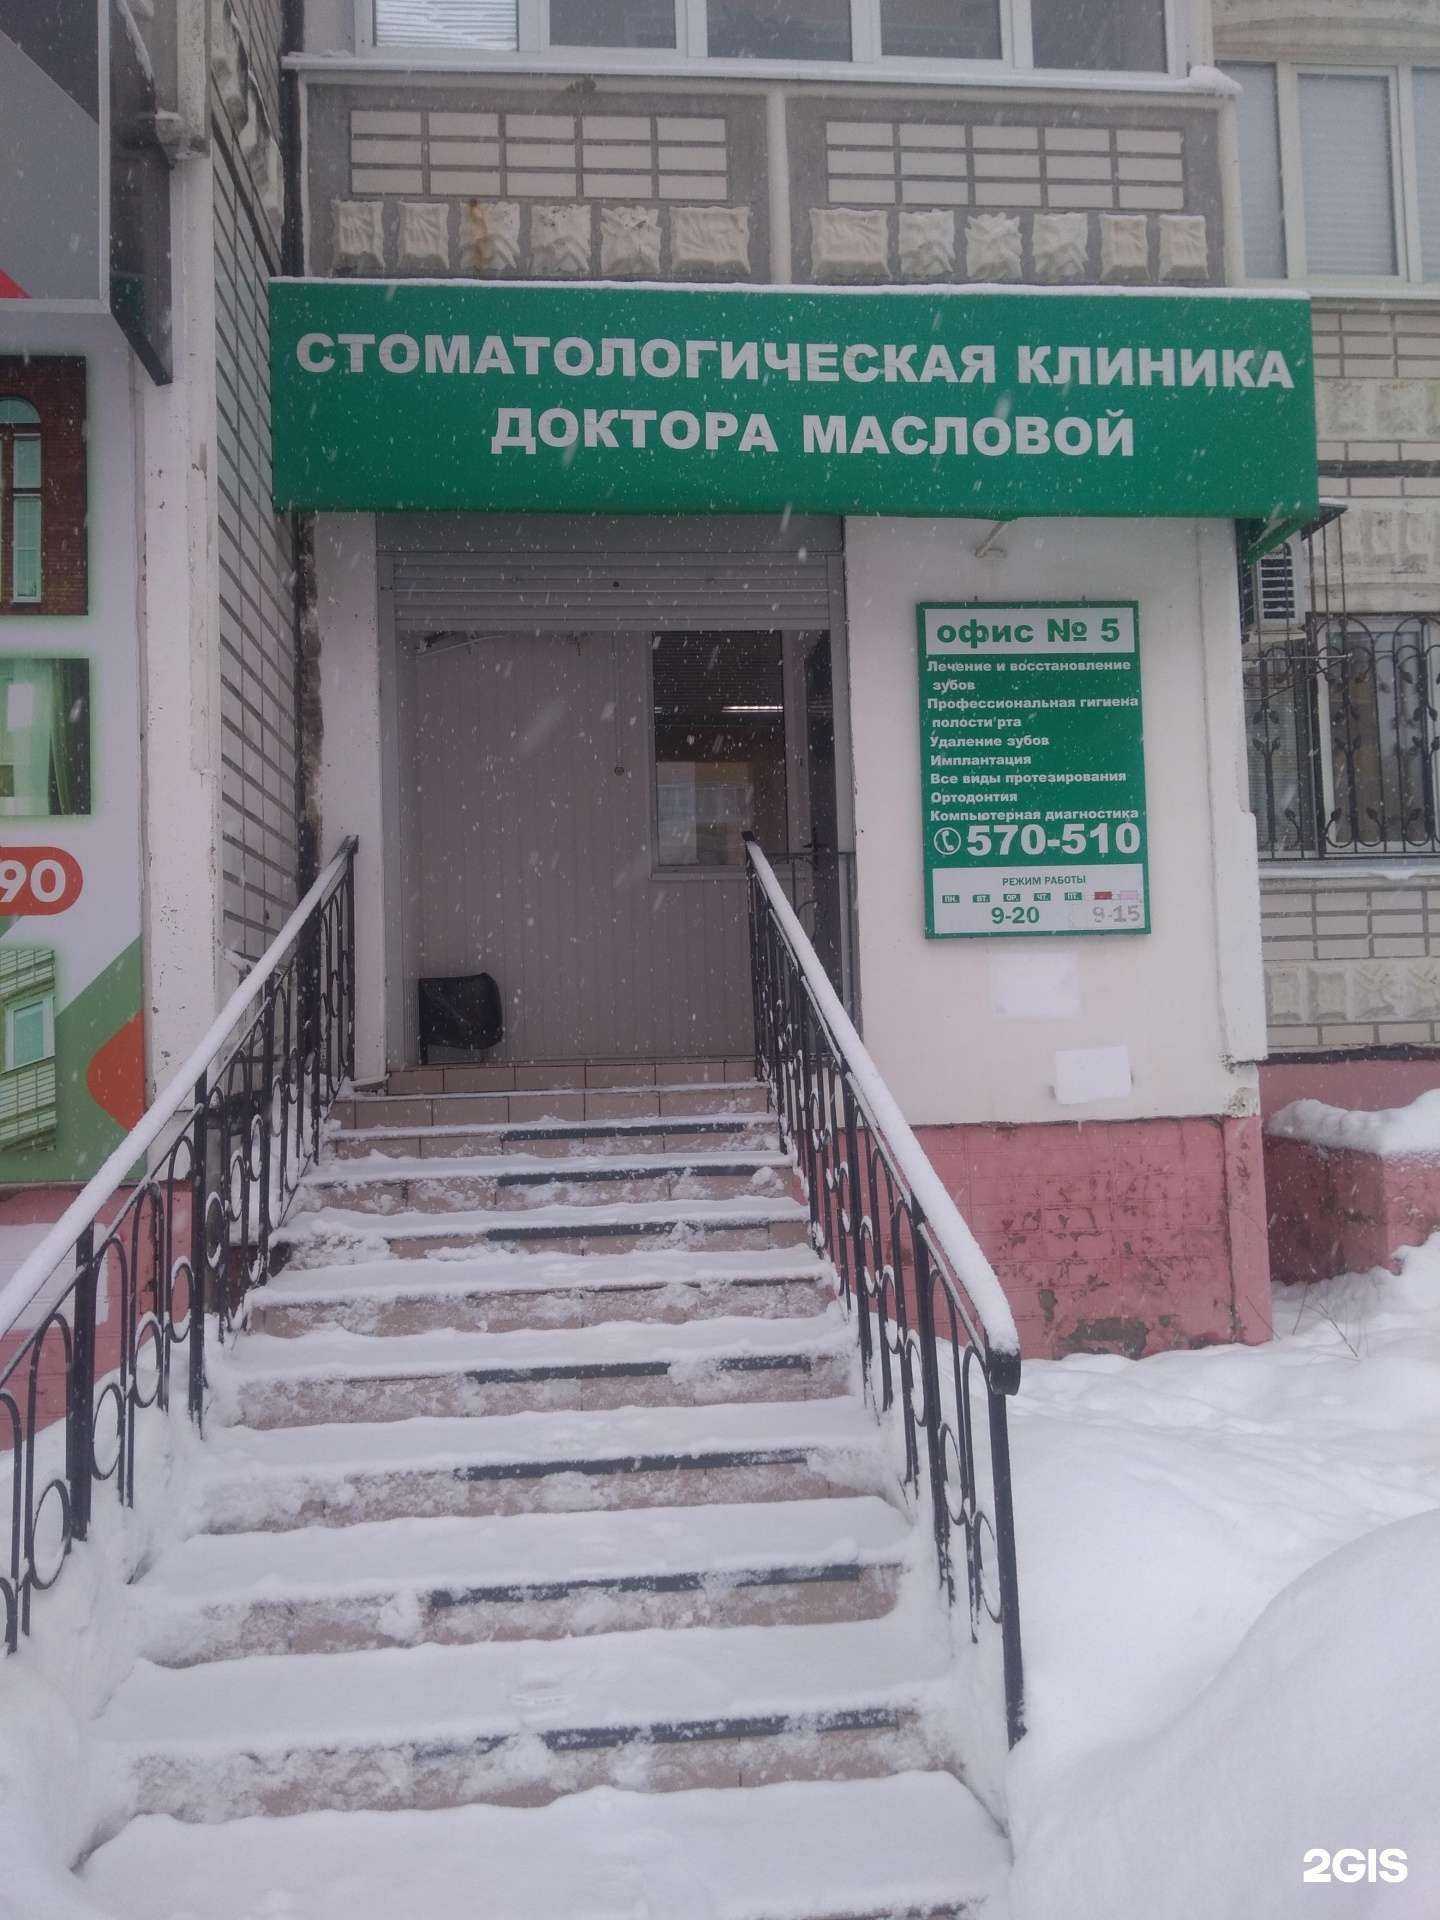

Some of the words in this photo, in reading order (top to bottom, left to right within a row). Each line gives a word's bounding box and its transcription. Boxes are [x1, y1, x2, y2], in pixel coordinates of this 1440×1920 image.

[296, 332, 996, 383] СТОМАТОЛОГИЧЕСКАЯ
[1017, 345, 1295, 389] КЛИНИКА
[491, 407, 779, 455] ДОКТОРА
[802, 409, 1134, 457] МАСЛОВОЙ
[936, 618, 1035, 649] офис
[1047, 618, 1088, 642] №
[1101, 618, 1121, 642] 5
[927, 660, 992, 672] Лечение
[996, 661, 1005, 671] и
[1010, 660, 1131, 672] восстановление
[932, 680, 976, 695] зубов
[927, 697, 1076, 712] Профессиональная
[1080, 697, 1139, 708] гигиена
[932, 717, 993, 729] полости
[997, 717, 1022, 731] рта
[930, 735, 1002, 749] Удаление
[1007, 734, 1050, 749] зубов
[930, 754, 1032, 767] Имплантация
[930, 773, 958, 784] Все
[963, 774, 1001, 785] виды
[1005, 772, 1127, 787] протезирования
[930, 791, 1018, 805] Ортодонтия
[930, 809, 1041, 822] Компьютерная
[1045, 809, 1139, 821] диагностика
[966, 822, 1141, 856] 570-510
[1002, 877, 1042, 886] РЕЖИМ
[1044, 875, 1086, 885] РАБОТЫ
[991, 906, 1040, 924] 9-20
[1092, 905, 1140, 923] 9-15
